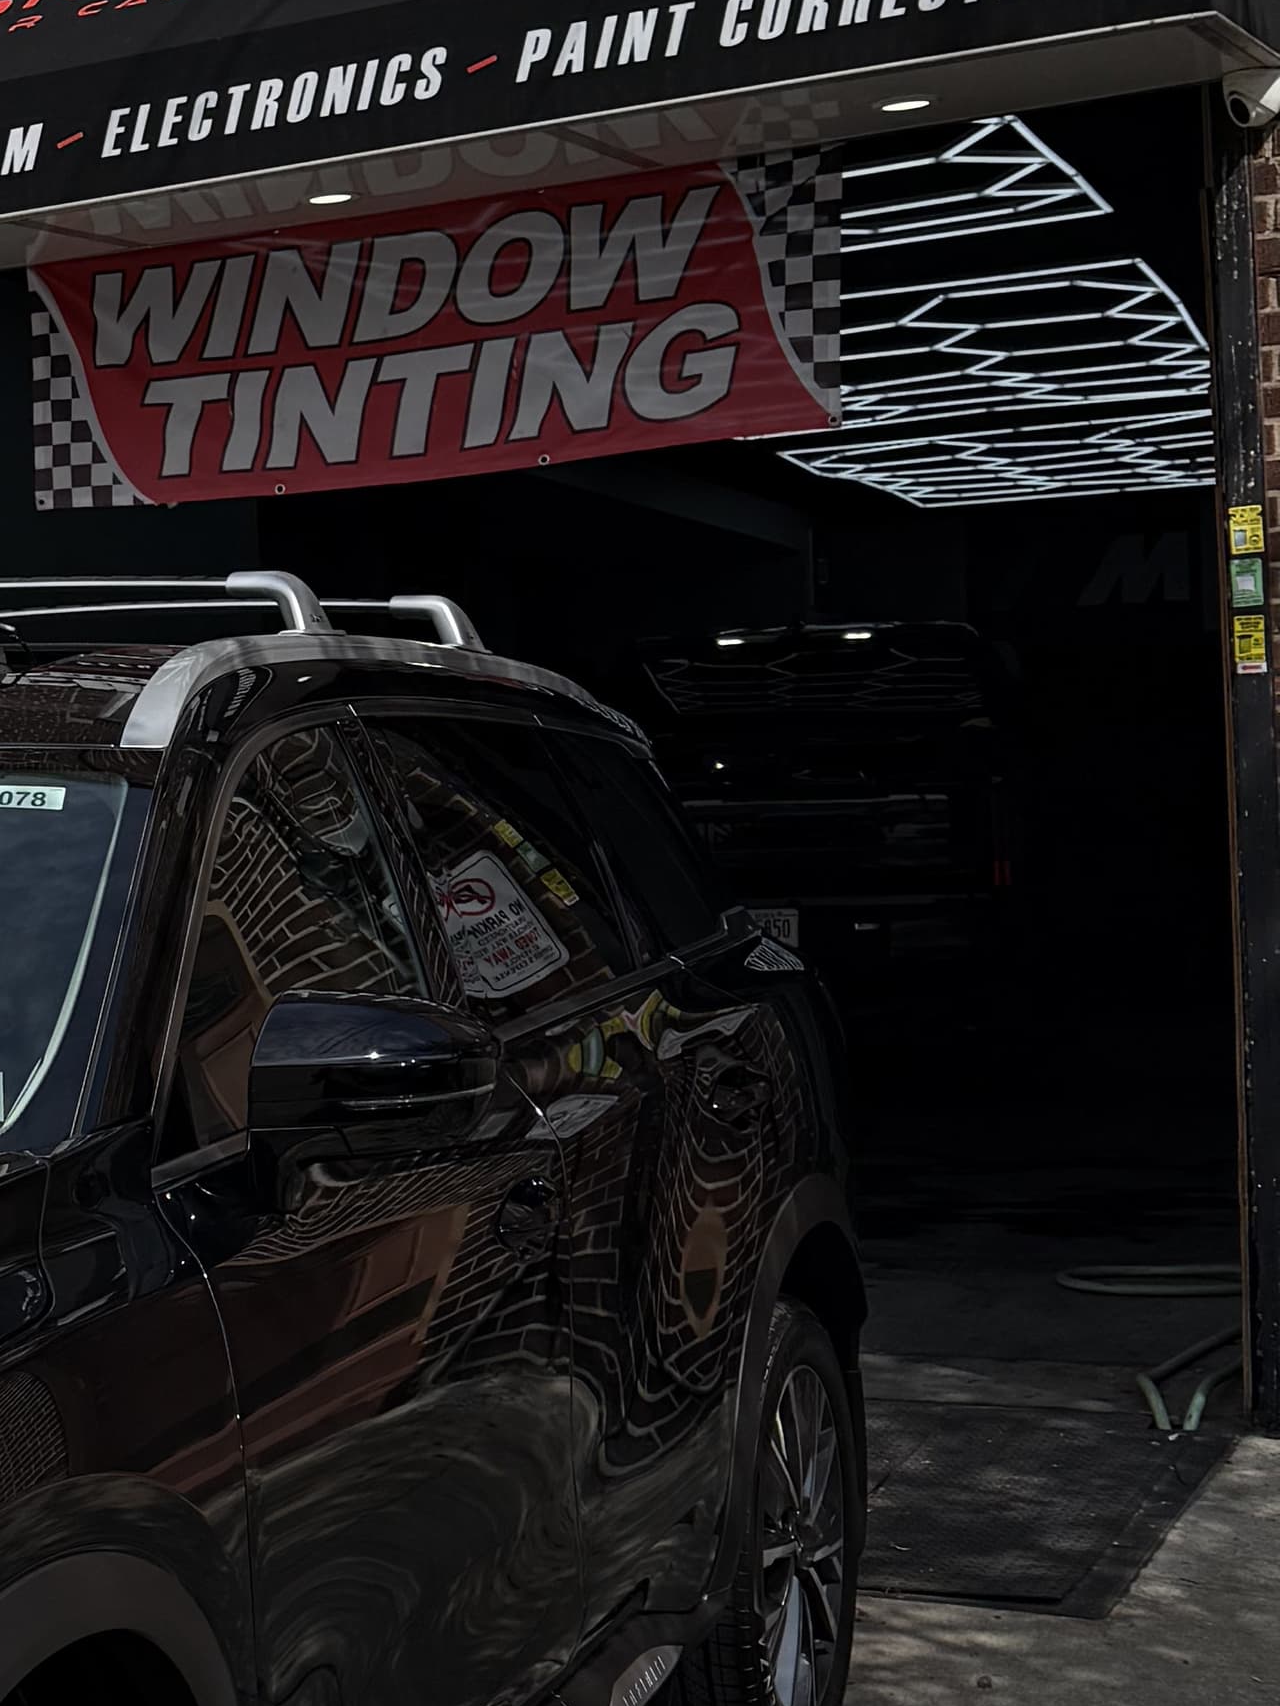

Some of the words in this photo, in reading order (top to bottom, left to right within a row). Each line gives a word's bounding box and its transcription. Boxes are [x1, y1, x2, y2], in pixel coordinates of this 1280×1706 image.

[101, 46, 448, 161] ELECTRONICS
[516, 0, 696, 84] PAINT
[91, 177, 736, 369] WINDOW
[140, 298, 746, 479] TINTING
